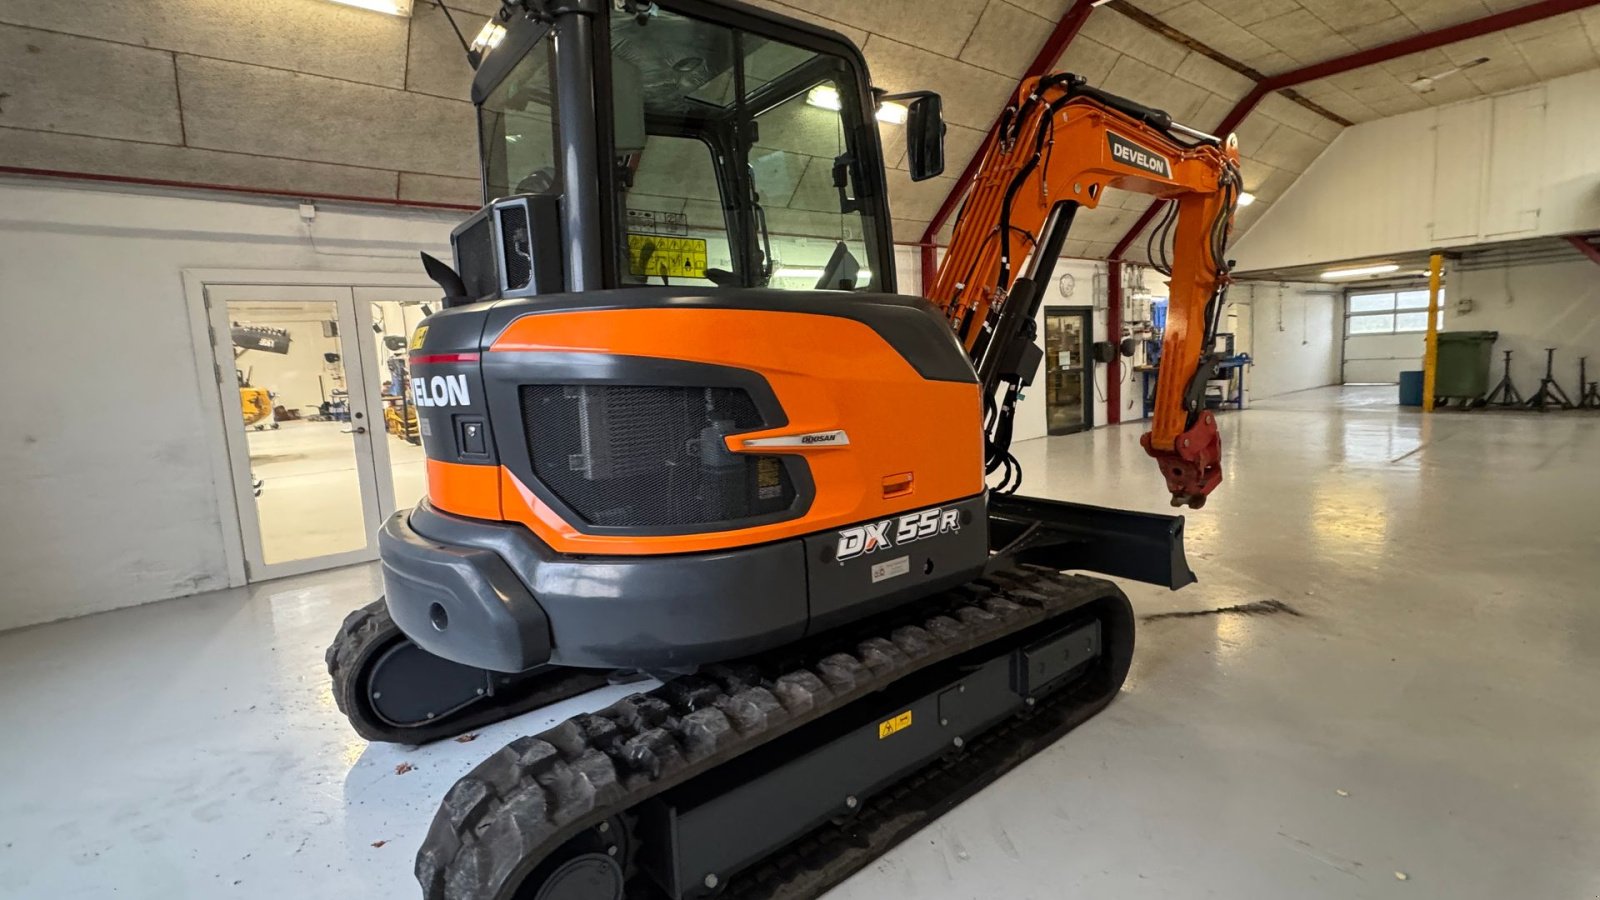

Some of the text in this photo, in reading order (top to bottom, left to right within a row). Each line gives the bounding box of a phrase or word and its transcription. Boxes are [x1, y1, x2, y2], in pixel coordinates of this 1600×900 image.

[1113, 143, 1164, 174] DEVELON
[801, 434, 836, 444] DOOSAN
[837, 519, 893, 561] DX
